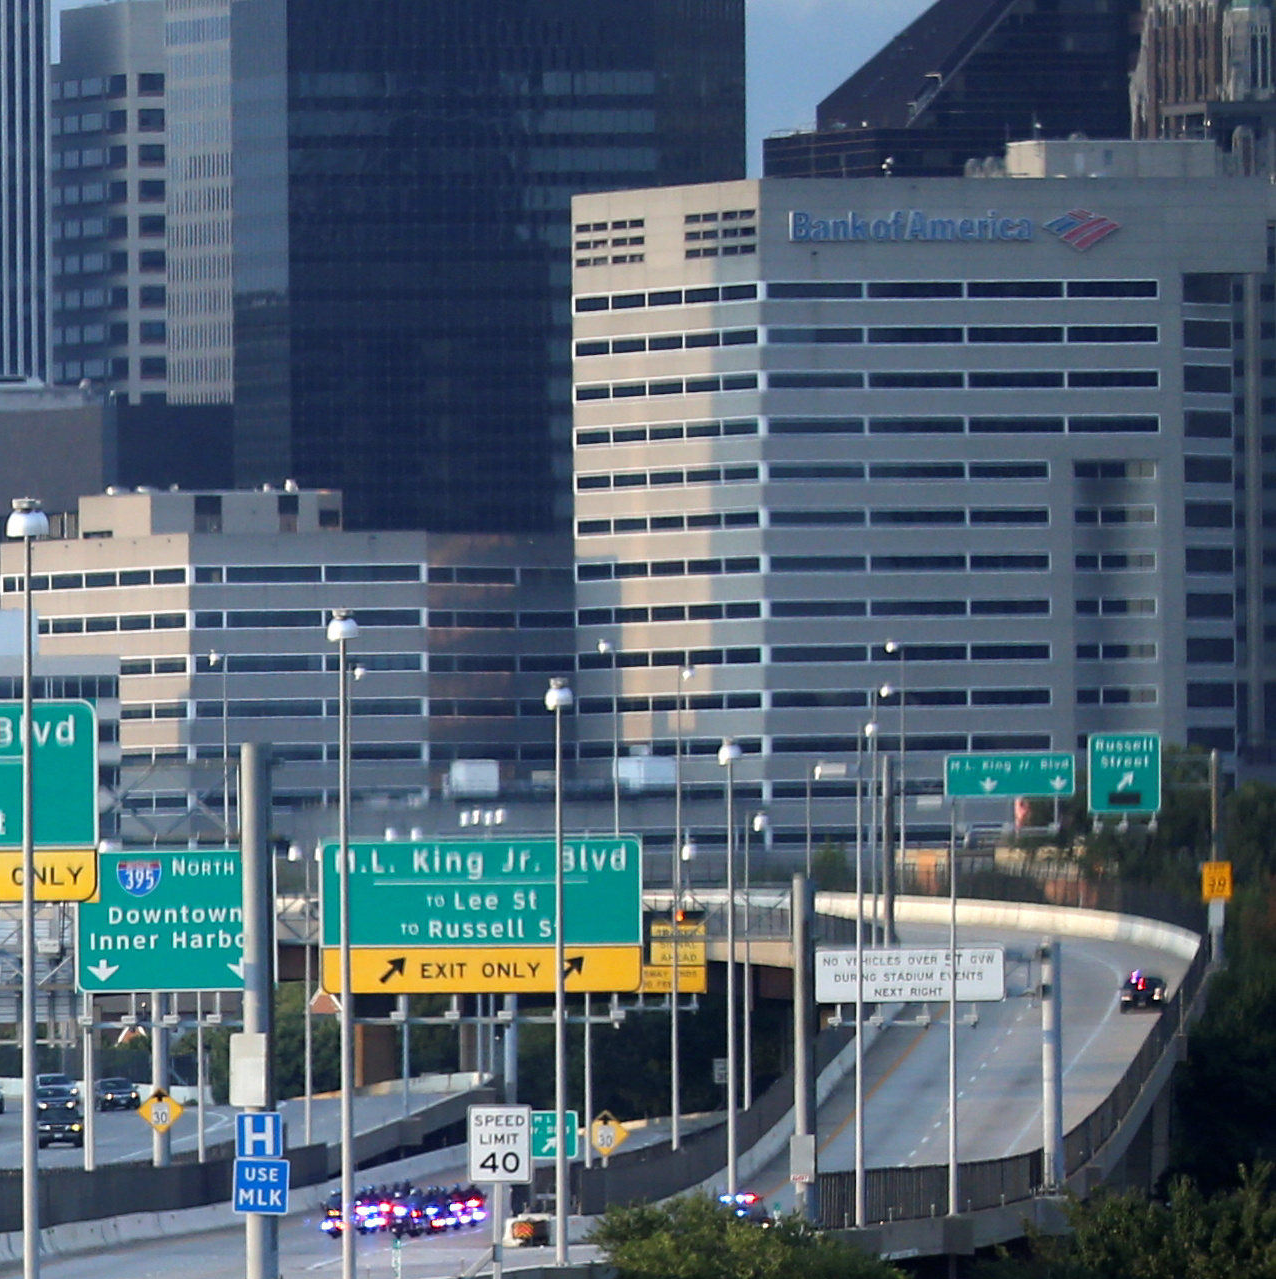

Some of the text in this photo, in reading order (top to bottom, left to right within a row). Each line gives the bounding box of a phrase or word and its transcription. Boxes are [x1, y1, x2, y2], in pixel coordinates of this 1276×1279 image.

[904, 209, 1034, 241] America
[1095, 736, 1153, 753] Russell
[982, 758, 1012, 774] King
[1040, 757, 1069, 771] Blvd
[1100, 753, 1149, 769] Street
[412, 845, 484, 880] King
[501, 847, 541, 873] Jr.
[11, 865, 85, 887] ONLY
[125, 856, 235, 891] 395 NORTH
[426, 889, 538, 910] TO Lee St
[108, 905, 243, 925] Downtown
[400, 918, 558, 938] TO Russell S
[90, 929, 246, 951] Inner Harbo
[823, 957, 839, 967] NO
[845, 956, 901, 967] VEHICLES
[907, 956, 938, 966] OVER
[420, 962, 541, 979] EXIT ONLY
[834, 973, 877, 984] DURNG
[883, 971, 934, 982] STADIUM
[874, 986, 943, 998] NEXT RIGHT
[153, 1111, 168, 1124] 30
[474, 1114, 525, 1127] SPEED
[244, 1115, 274, 1156] H
[479, 1132, 520, 1145] LIMIT
[598, 1134, 613, 1147] 30
[479, 1151, 520, 1173] 40
[244, 1167, 279, 1182] USE
[238, 1188, 282, 1207] MLK
